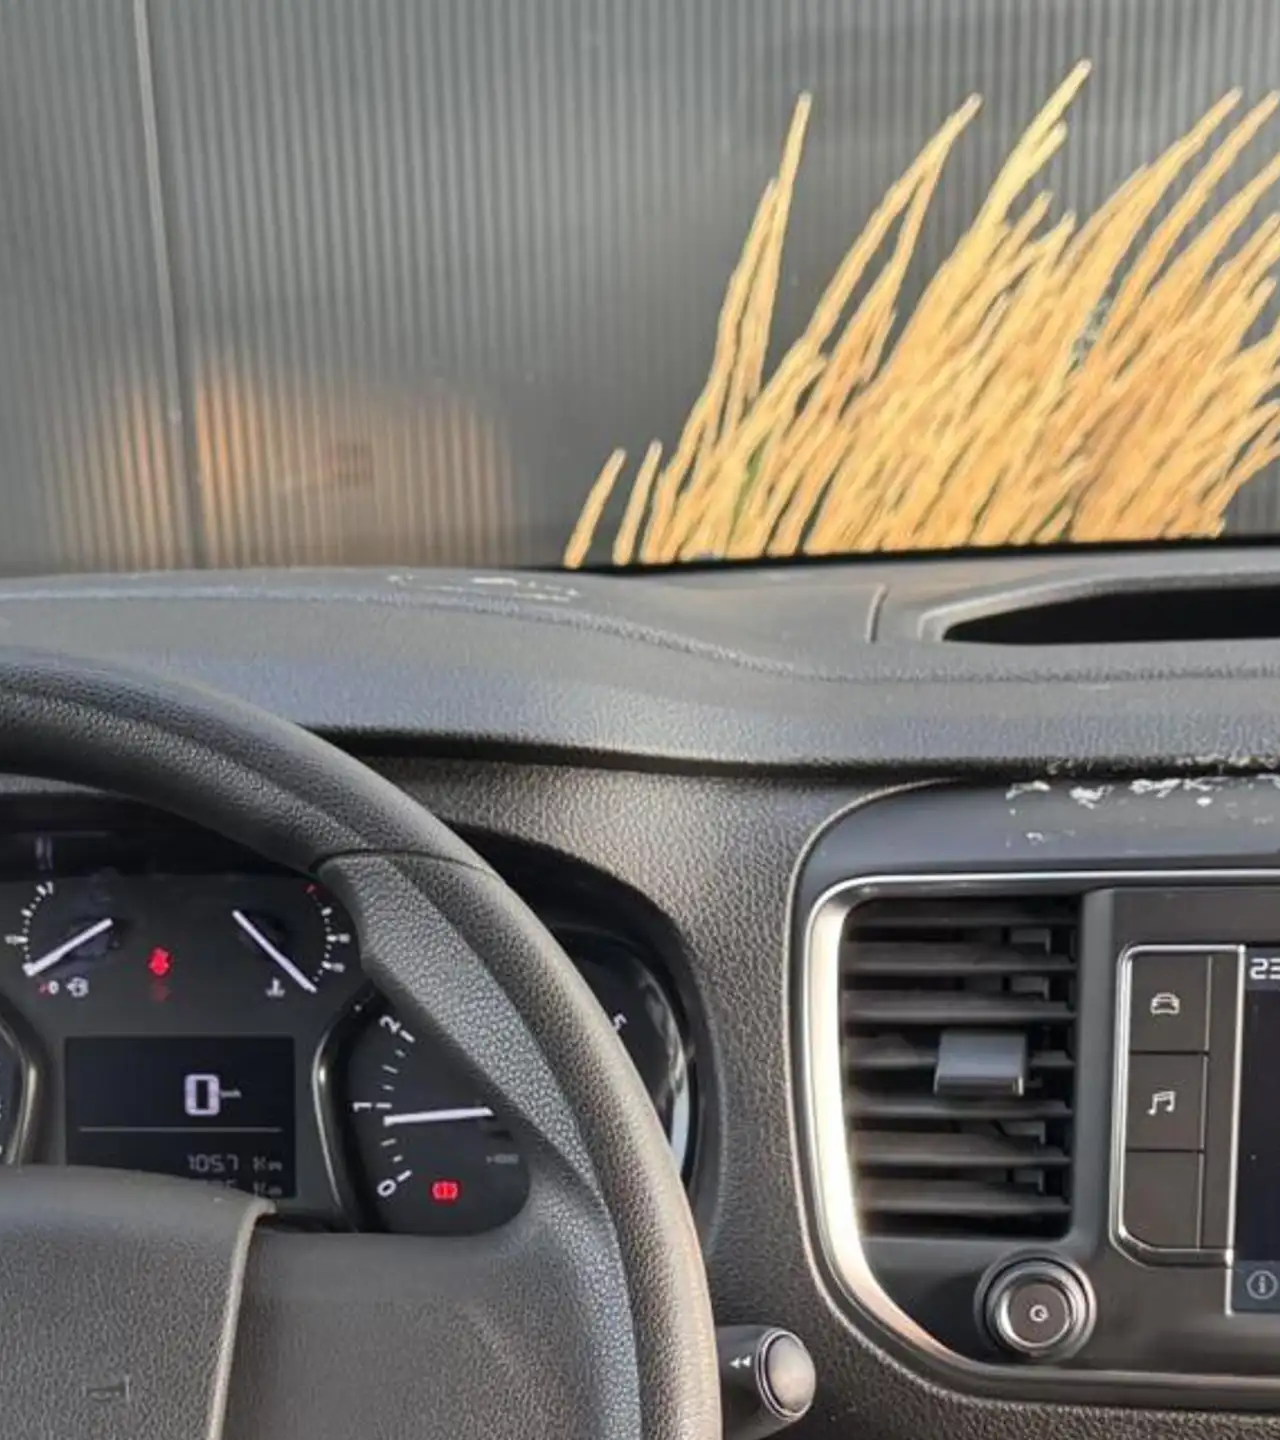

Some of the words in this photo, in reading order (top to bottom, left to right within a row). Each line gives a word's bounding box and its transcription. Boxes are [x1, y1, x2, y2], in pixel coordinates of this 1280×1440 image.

[379, 1014, 402, 1033] 2
[184, 1073, 219, 1116] 0
[353, 1101, 372, 1112] 1
[187, 1152, 239, 1173] 1057
[376, 1177, 397, 1197] 0
